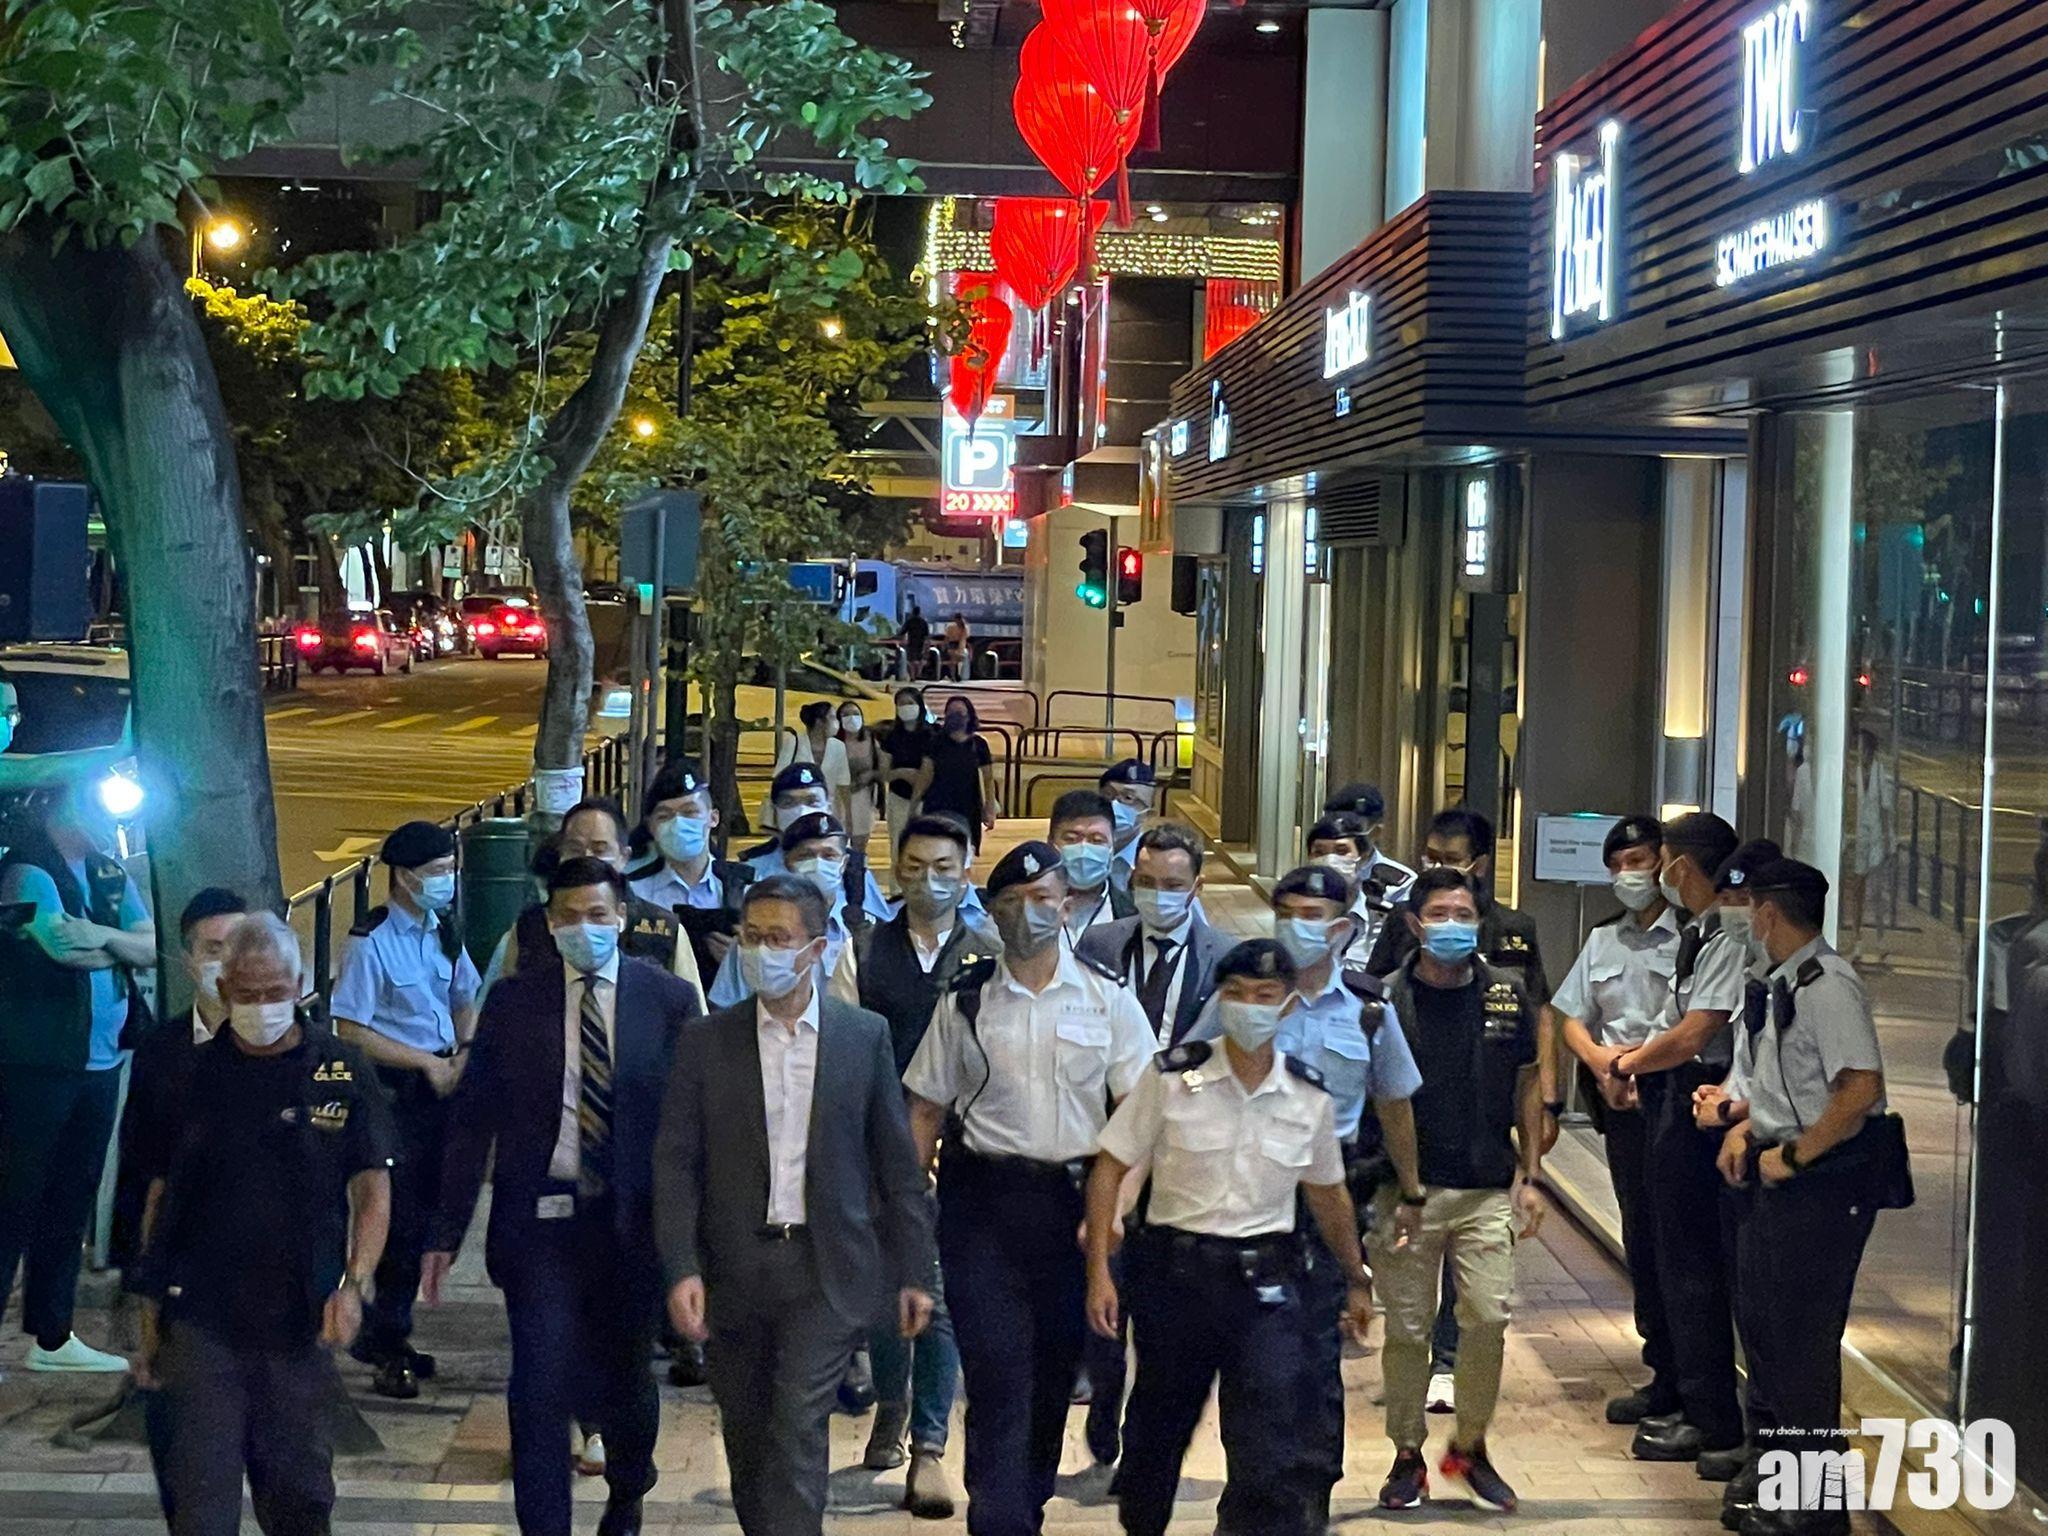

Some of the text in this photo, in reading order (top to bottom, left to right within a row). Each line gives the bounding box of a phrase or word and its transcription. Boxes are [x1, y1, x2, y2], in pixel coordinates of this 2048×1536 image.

[1739, 0, 1807, 173] IWC
[1716, 199, 1824, 287] SCHAFFHAUSEN
[959, 438, 999, 486] P
[945, 493, 970, 511] 20
